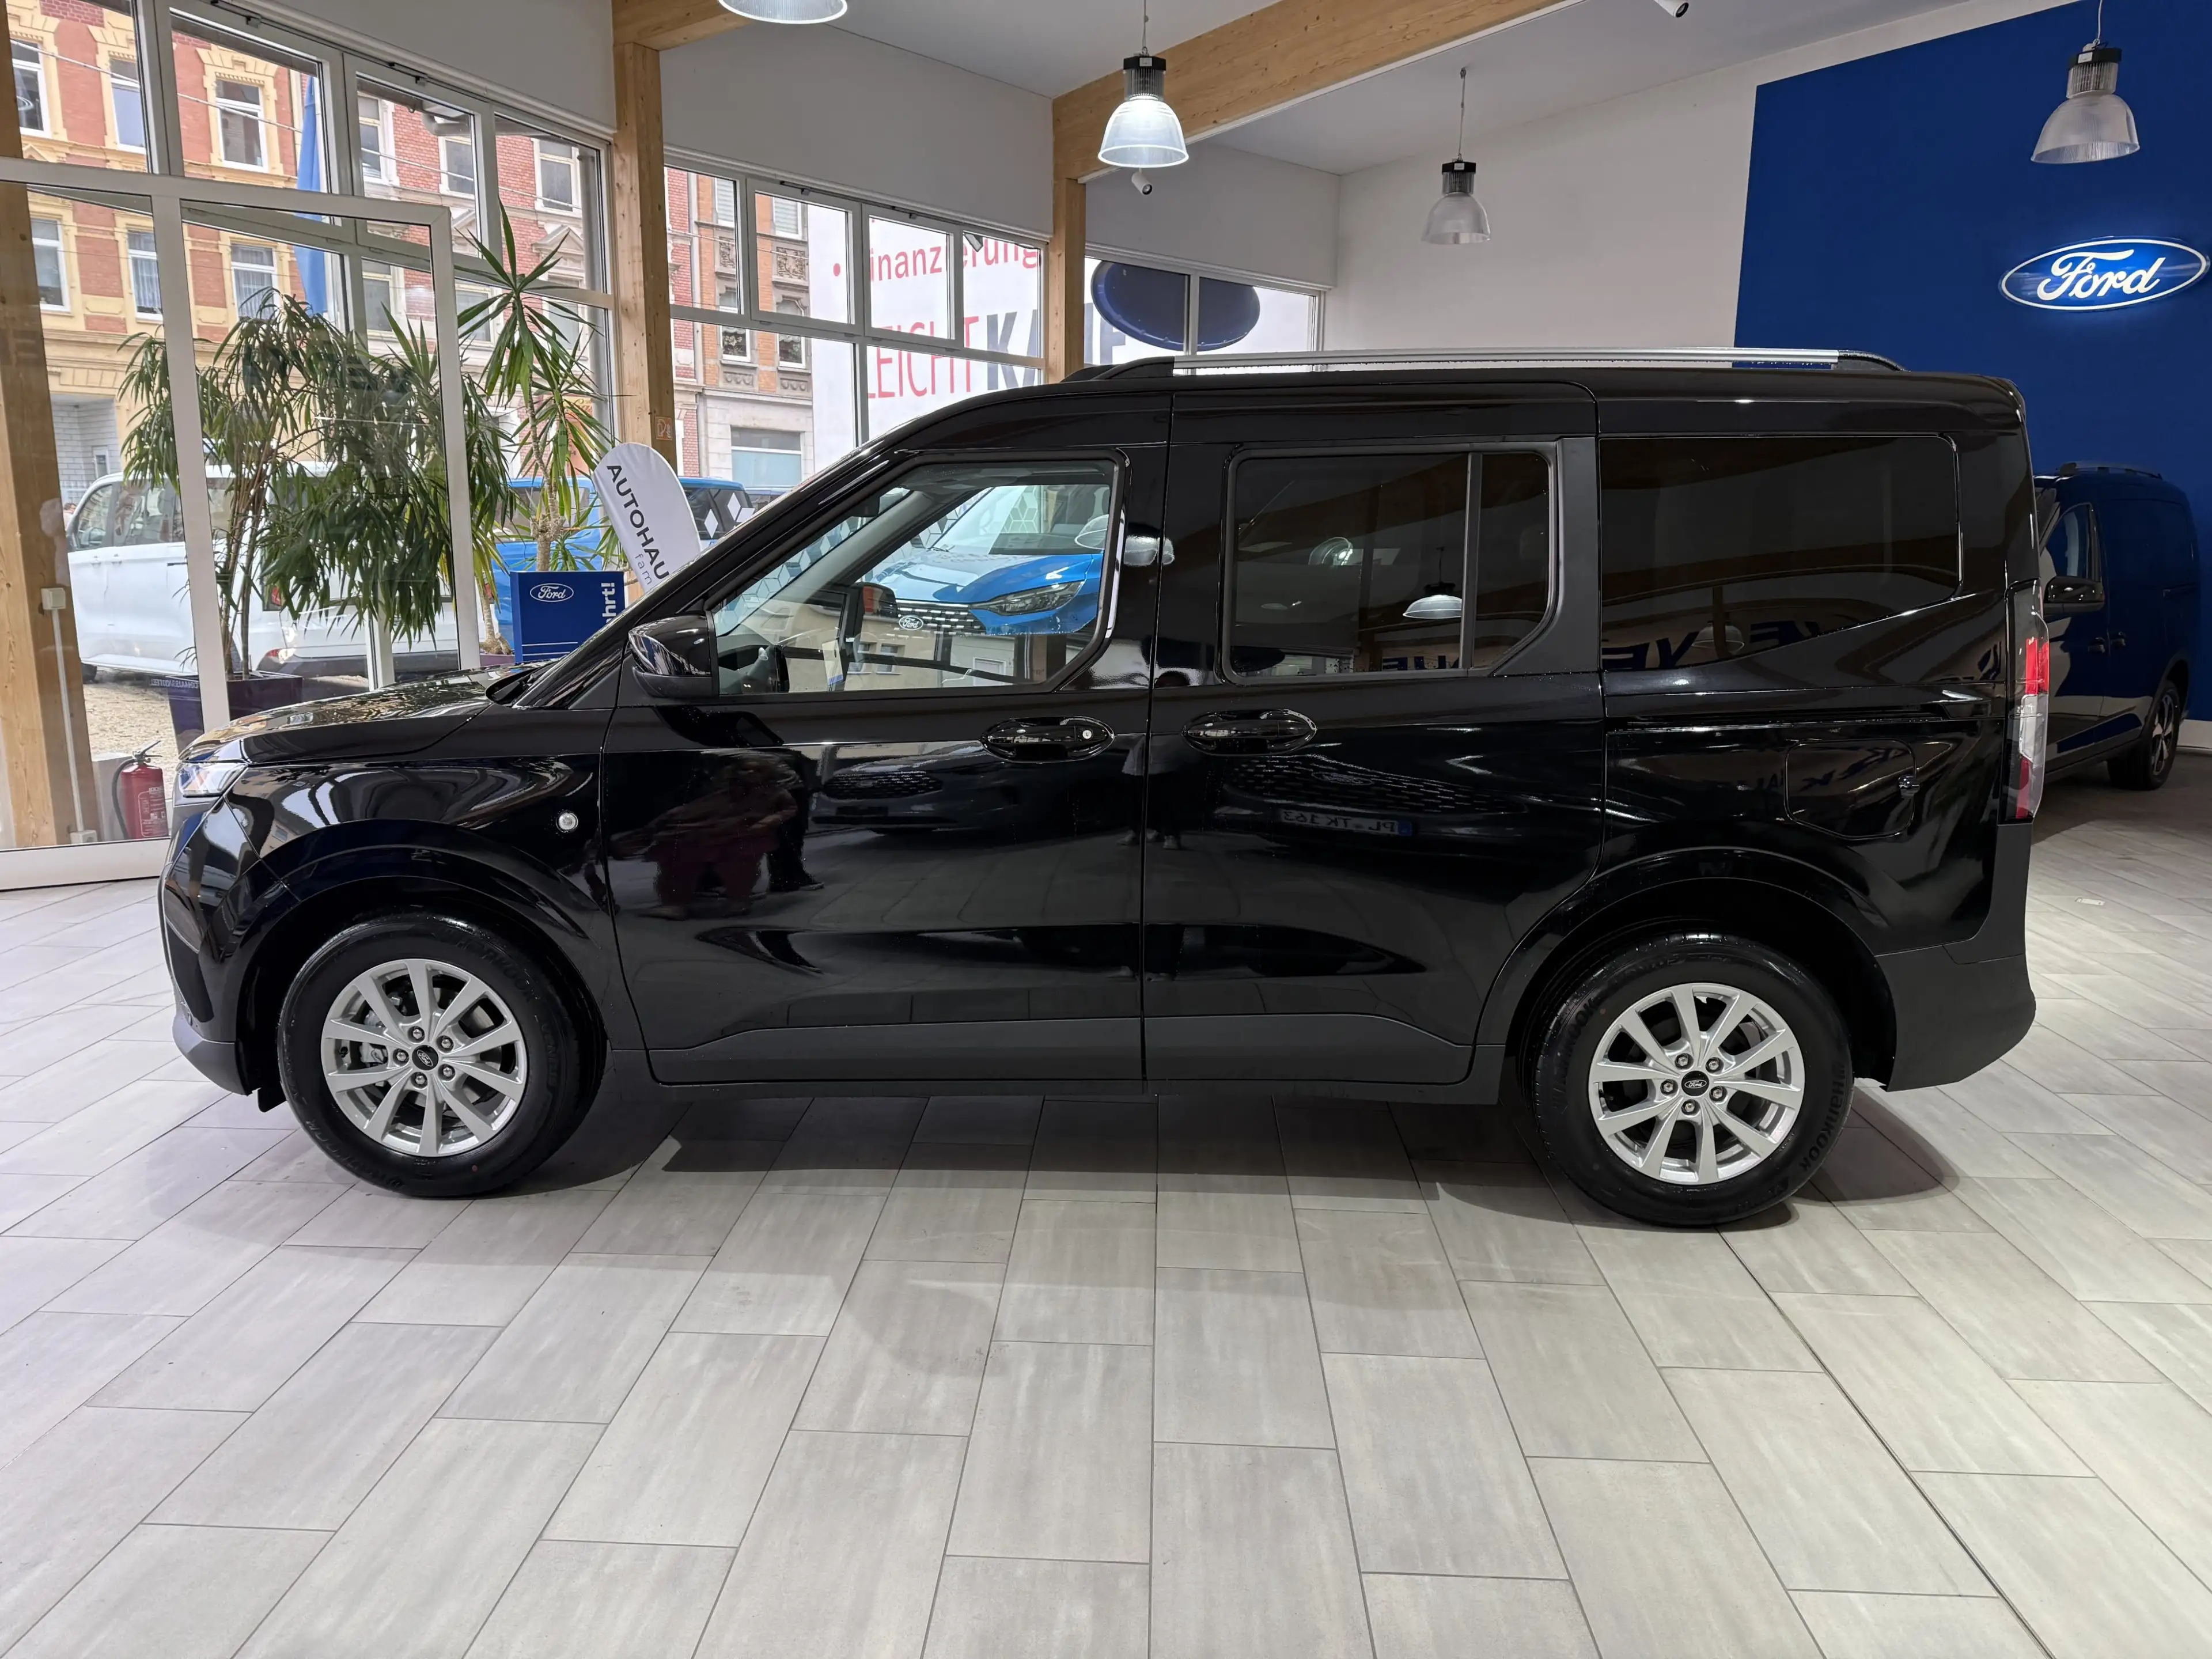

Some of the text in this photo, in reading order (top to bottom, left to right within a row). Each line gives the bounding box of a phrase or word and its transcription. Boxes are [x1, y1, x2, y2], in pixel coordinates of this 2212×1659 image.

[2036, 249, 2166, 301] Ford
[607, 465, 669, 579] AUTOHAU
[537, 585, 566, 599] Ford
[601, 582, 616, 623] hrt!
[903, 618, 919, 628] Ford
